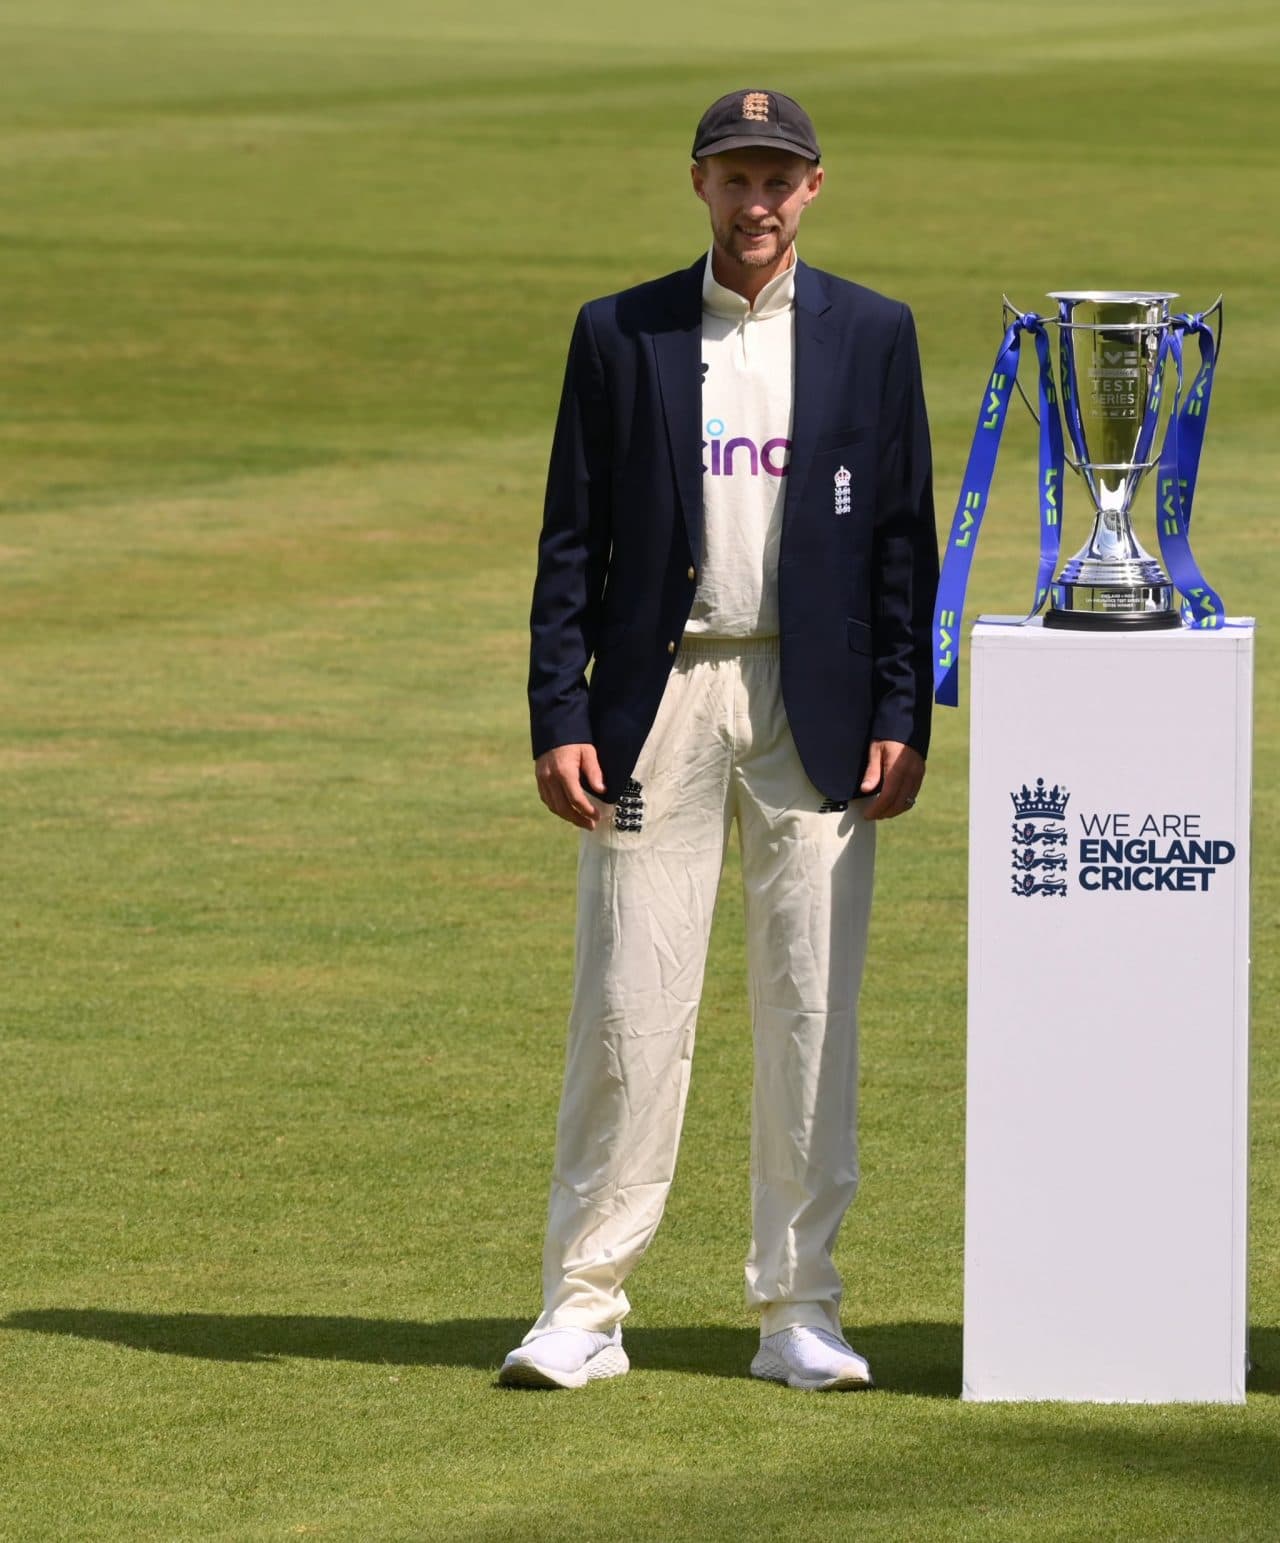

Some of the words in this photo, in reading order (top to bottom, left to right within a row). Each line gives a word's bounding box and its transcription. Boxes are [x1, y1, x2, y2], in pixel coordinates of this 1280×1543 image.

[1091, 380, 1135, 391] TEST
[1091, 393, 1135, 405] SERIES
[701, 419, 792, 477] inc
[1079, 813, 1130, 837] WE
[1139, 814, 1201, 838] ARE
[1079, 839, 1236, 865] ENGLAND
[1078, 866, 1216, 891] CRICKET
